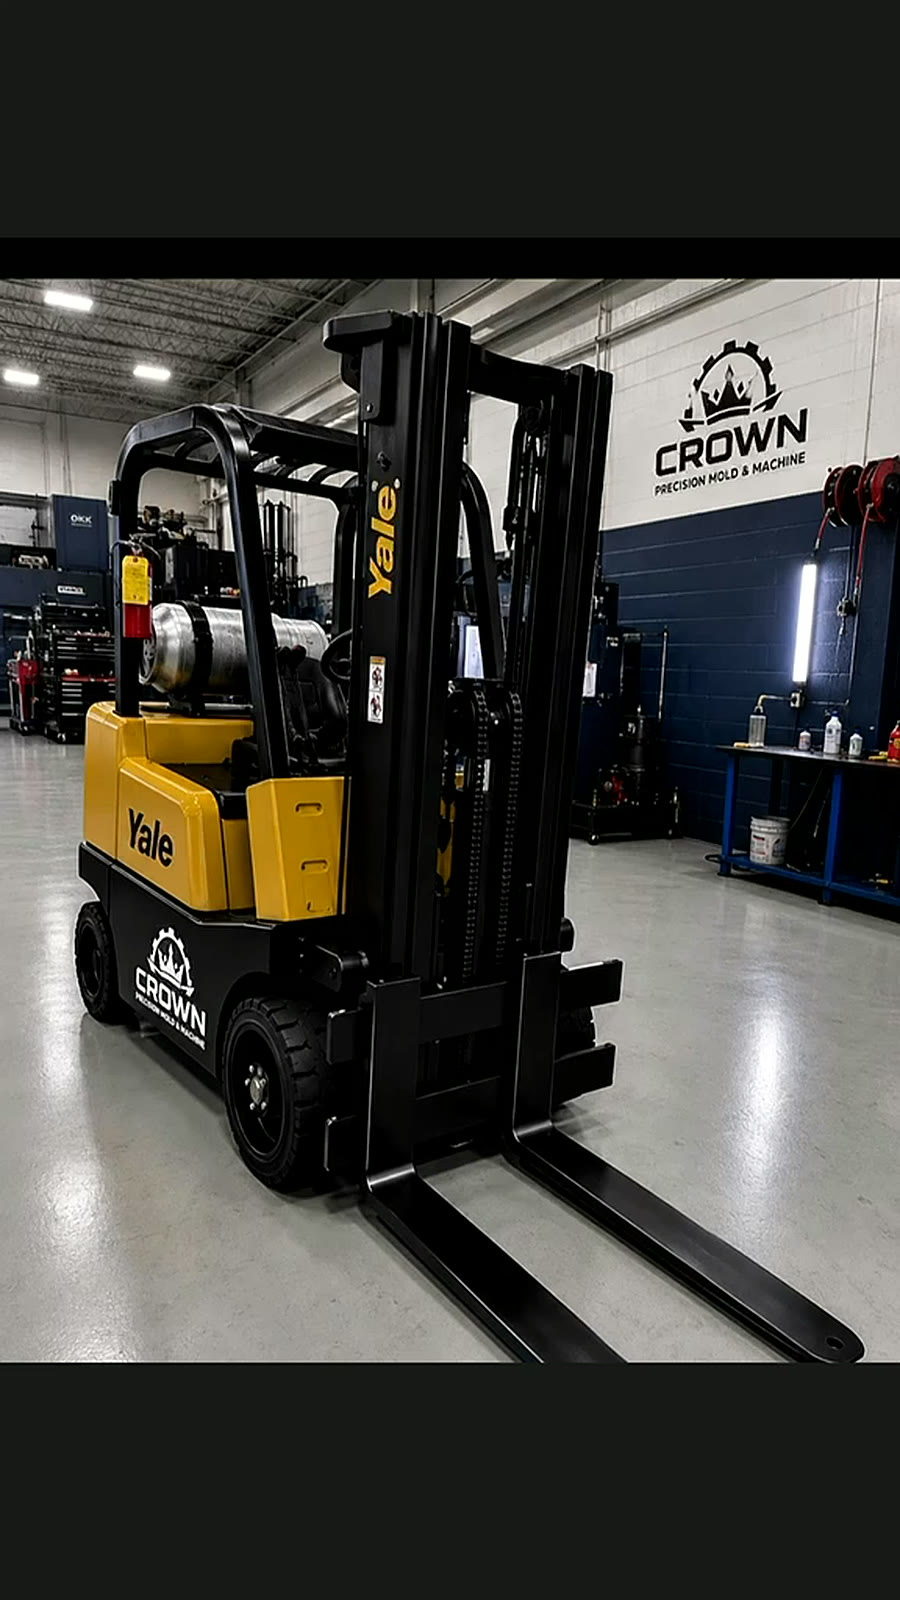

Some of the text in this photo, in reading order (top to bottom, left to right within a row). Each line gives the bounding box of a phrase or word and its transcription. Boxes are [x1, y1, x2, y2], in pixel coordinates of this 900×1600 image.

[655, 452, 806, 496] PRECISION MOLD & MACHINE
[656, 408, 808, 477] CROWN
[368, 485, 397, 598] Yale
[128, 807, 174, 867] Yale
[135, 966, 206, 1036] CROWN
